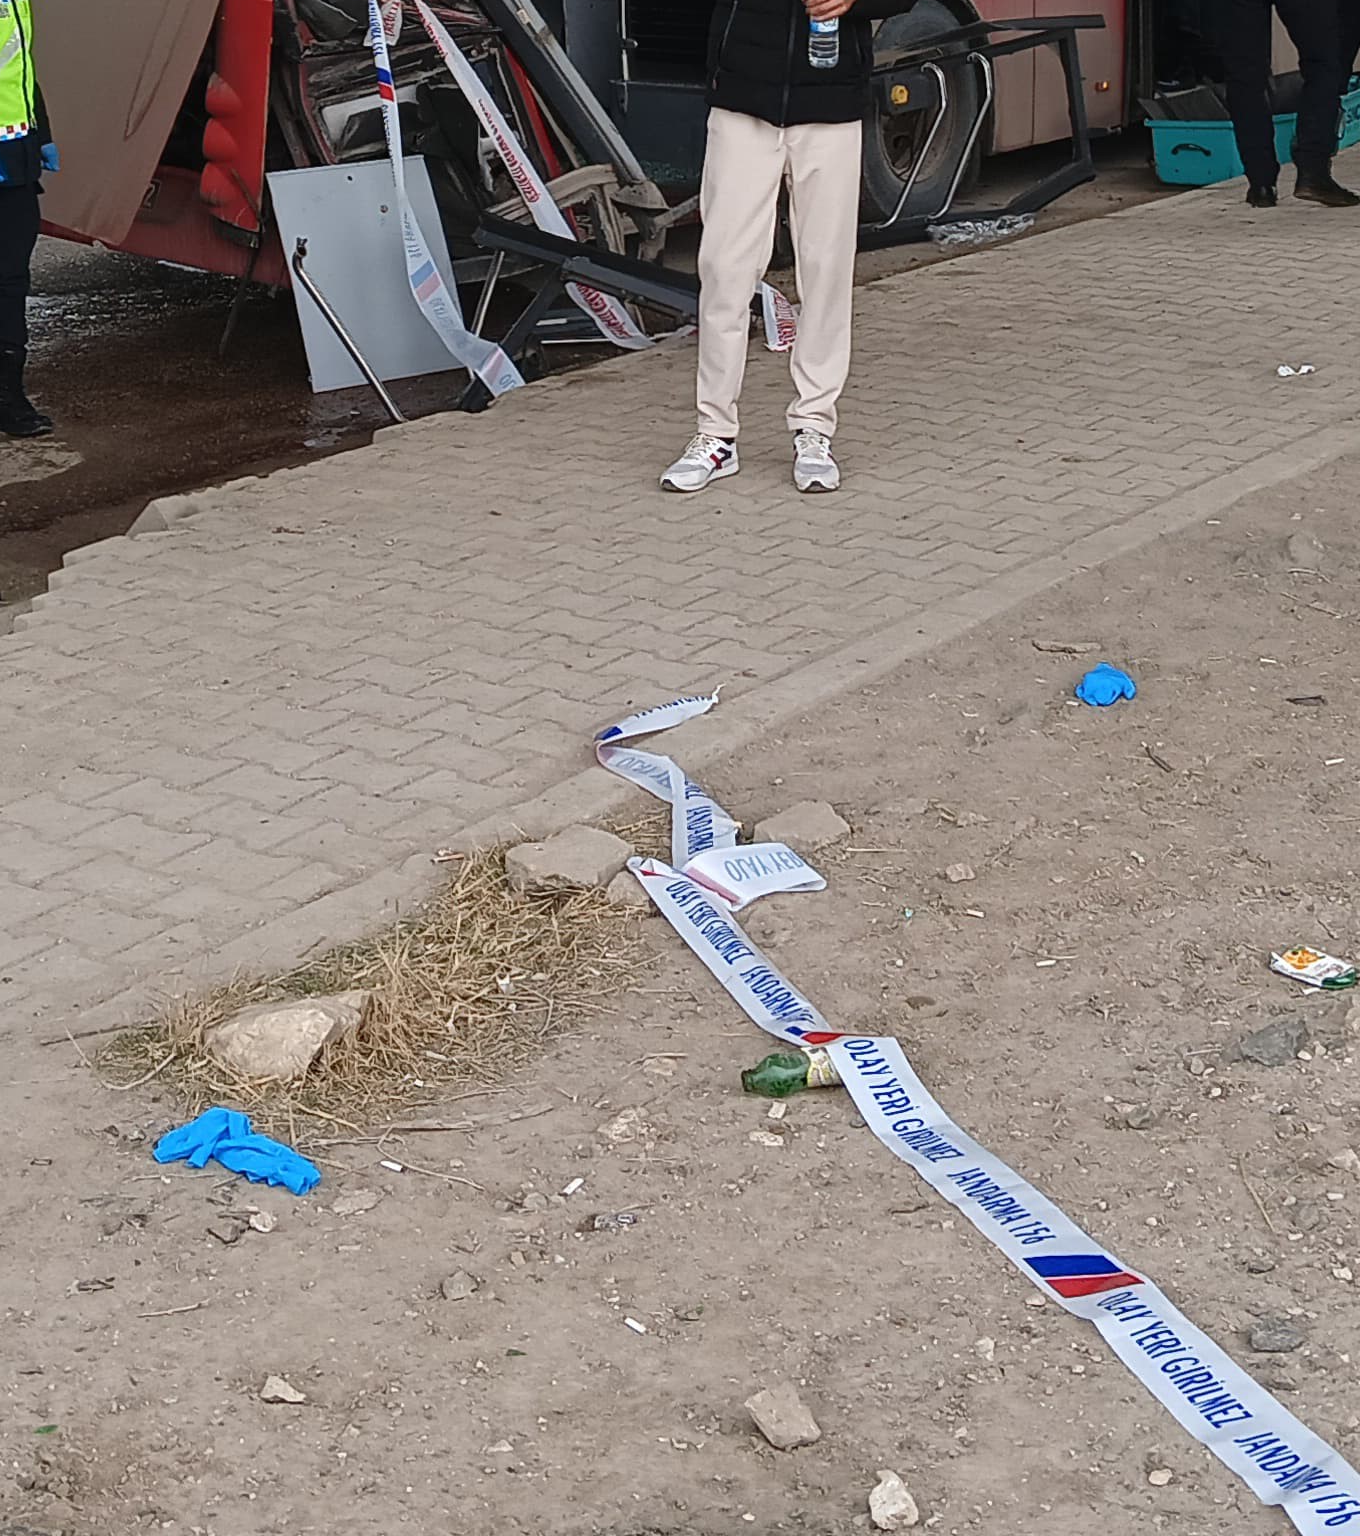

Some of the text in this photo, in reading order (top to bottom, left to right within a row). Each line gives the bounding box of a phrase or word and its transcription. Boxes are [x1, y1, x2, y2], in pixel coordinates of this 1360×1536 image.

[843, 1039, 1057, 1246] OLAY YERİ GİRİLMEZ JANDARMA 156
[1096, 1290, 1153, 1323] OLAY
[1129, 1319, 1189, 1359] YERİ
[1160, 1356, 1254, 1431] GİRİLMEZ
